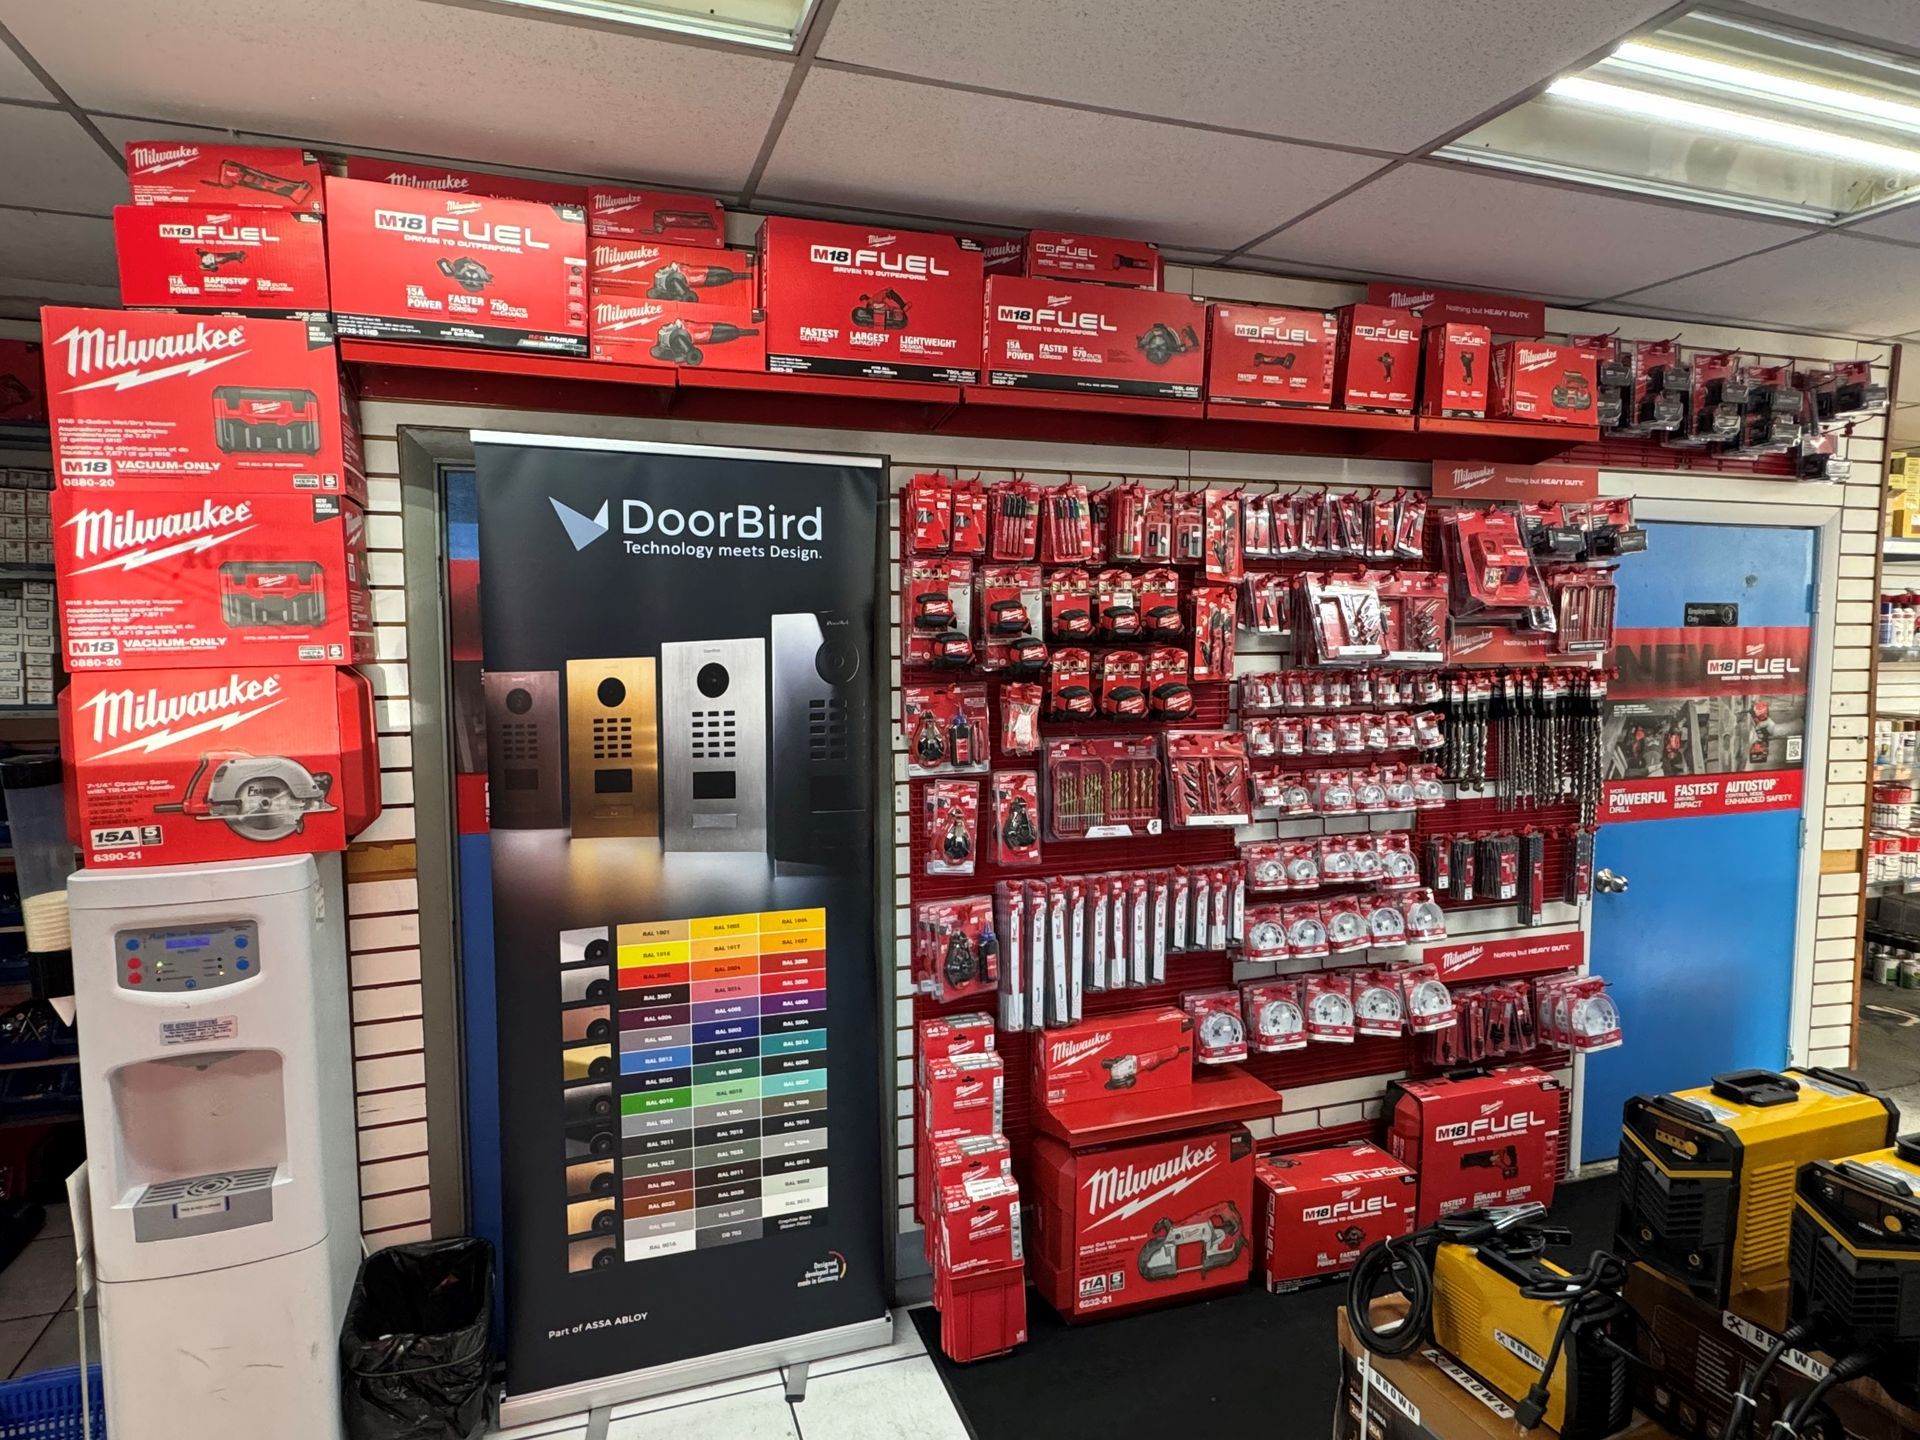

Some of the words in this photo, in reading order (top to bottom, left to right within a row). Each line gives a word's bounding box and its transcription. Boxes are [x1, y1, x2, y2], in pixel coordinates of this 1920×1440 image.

[131, 146, 199, 169] Milwaukee
[594, 194, 641, 209] Milwaukee
[161, 227, 192, 236] M18
[198, 226, 280, 242] FUEL
[379, 215, 423, 232] M18
[431, 216, 550, 250] FUEL
[404, 234, 440, 246] DRIVEN
[443, 238, 456, 248] TO
[592, 246, 660, 267] Milwaukee
[1056, 246, 1098, 258] FUEL
[814, 248, 849, 263] M18
[856, 249, 949, 276] FUEL
[833, 267, 862, 275] DRIVEN
[204, 277, 246, 286] RAPIDSTOP
[170, 286, 200, 295] POWER
[408, 299, 443, 310] POWER
[448, 294, 484, 306] FASTER
[492, 302, 508, 311] 750
[1390, 292, 1435, 308] Milwaukee
[594, 302, 662, 324] Milwaukee
[1446, 304, 1471, 316] Nothing
[1472, 307, 1482, 315] but
[1484, 308, 1510, 318] HEAVY
[1000, 308, 1031, 321] M18
[1036, 310, 1117, 332] FUEL
[800, 327, 839, 339] FASTEST
[1017, 325, 1042, 333] DRIVEN
[1236, 326, 1258, 337] M18
[1261, 327, 1317, 343] FUEL
[1376, 328, 1419, 341] FUEL
[850, 331, 890, 343] LARGEST
[900, 335, 957, 349] LIGHTWEIGHT
[52, 322, 247, 377] Milwaukee
[1006, 342, 1020, 350] 15A
[1040, 344, 1068, 354] FASTER
[1006, 352, 1034, 361] POWER
[1517, 349, 1558, 367] Milwaukee
[65, 462, 106, 473] M18
[116, 461, 220, 472] VACUUM-ONLY
[62, 478, 116, 487] 0880-20
[1452, 466, 1496, 485] Milwaukee
[1540, 478, 1563, 486] HEAVY
[623, 498, 823, 541] DoorBird
[60, 498, 252, 558] Milwaukee
[624, 540, 713, 559] Technology
[719, 544, 765, 558] meets
[770, 546, 823, 562] Design.
[73, 642, 115, 654] M18
[123, 637, 226, 649] VACUUM-ONLY
[70, 658, 122, 668] 0880-20
[1710, 662, 1733, 674] M18
[1737, 658, 1801, 674] FUEL
[78, 674, 280, 744] Milwaukee
[1674, 782, 1719, 796] FASTEST
[1725, 778, 1778, 793] AUTOSTOP
[1609, 792, 1667, 807] POWERFUL
[1674, 801, 1703, 810] IMPACT
[1725, 796, 1764, 805] ENHANCED
[1765, 794, 1792, 803] SAFETY
[1609, 805, 1631, 814] DRILL
[94, 830, 135, 845] 15A
[94, 852, 142, 864] 6390-21
[1441, 946, 1484, 969] Milwaukee
[1494, 951, 1517, 960] Nothing
[1518, 950, 1527, 959] but
[1528, 946, 1550, 958] HEAVY
[1049, 1031, 1113, 1063] Milwaukee
[1438, 1126, 1466, 1140] M18
[1471, 1111, 1545, 1136] FUEL
[1081, 1143, 1217, 1216] Milwaukee
[1474, 1190, 1502, 1201] DURABLE
[1507, 1186, 1531, 1196] LIGHTER
[1305, 1208, 1329, 1220] M18
[1334, 1196, 1397, 1217] FUEL
[1440, 1198, 1467, 1209] FASTEST
[1081, 1276, 1104, 1291] 11A
[548, 1328, 570, 1339] Part
[572, 1324, 584, 1333] of
[585, 1319, 612, 1331] ASSA
[614, 1312, 648, 1325] ABLOY
[1375, 1374, 1416, 1417] BROWN
[1450, 1367, 1511, 1414] BROWN
